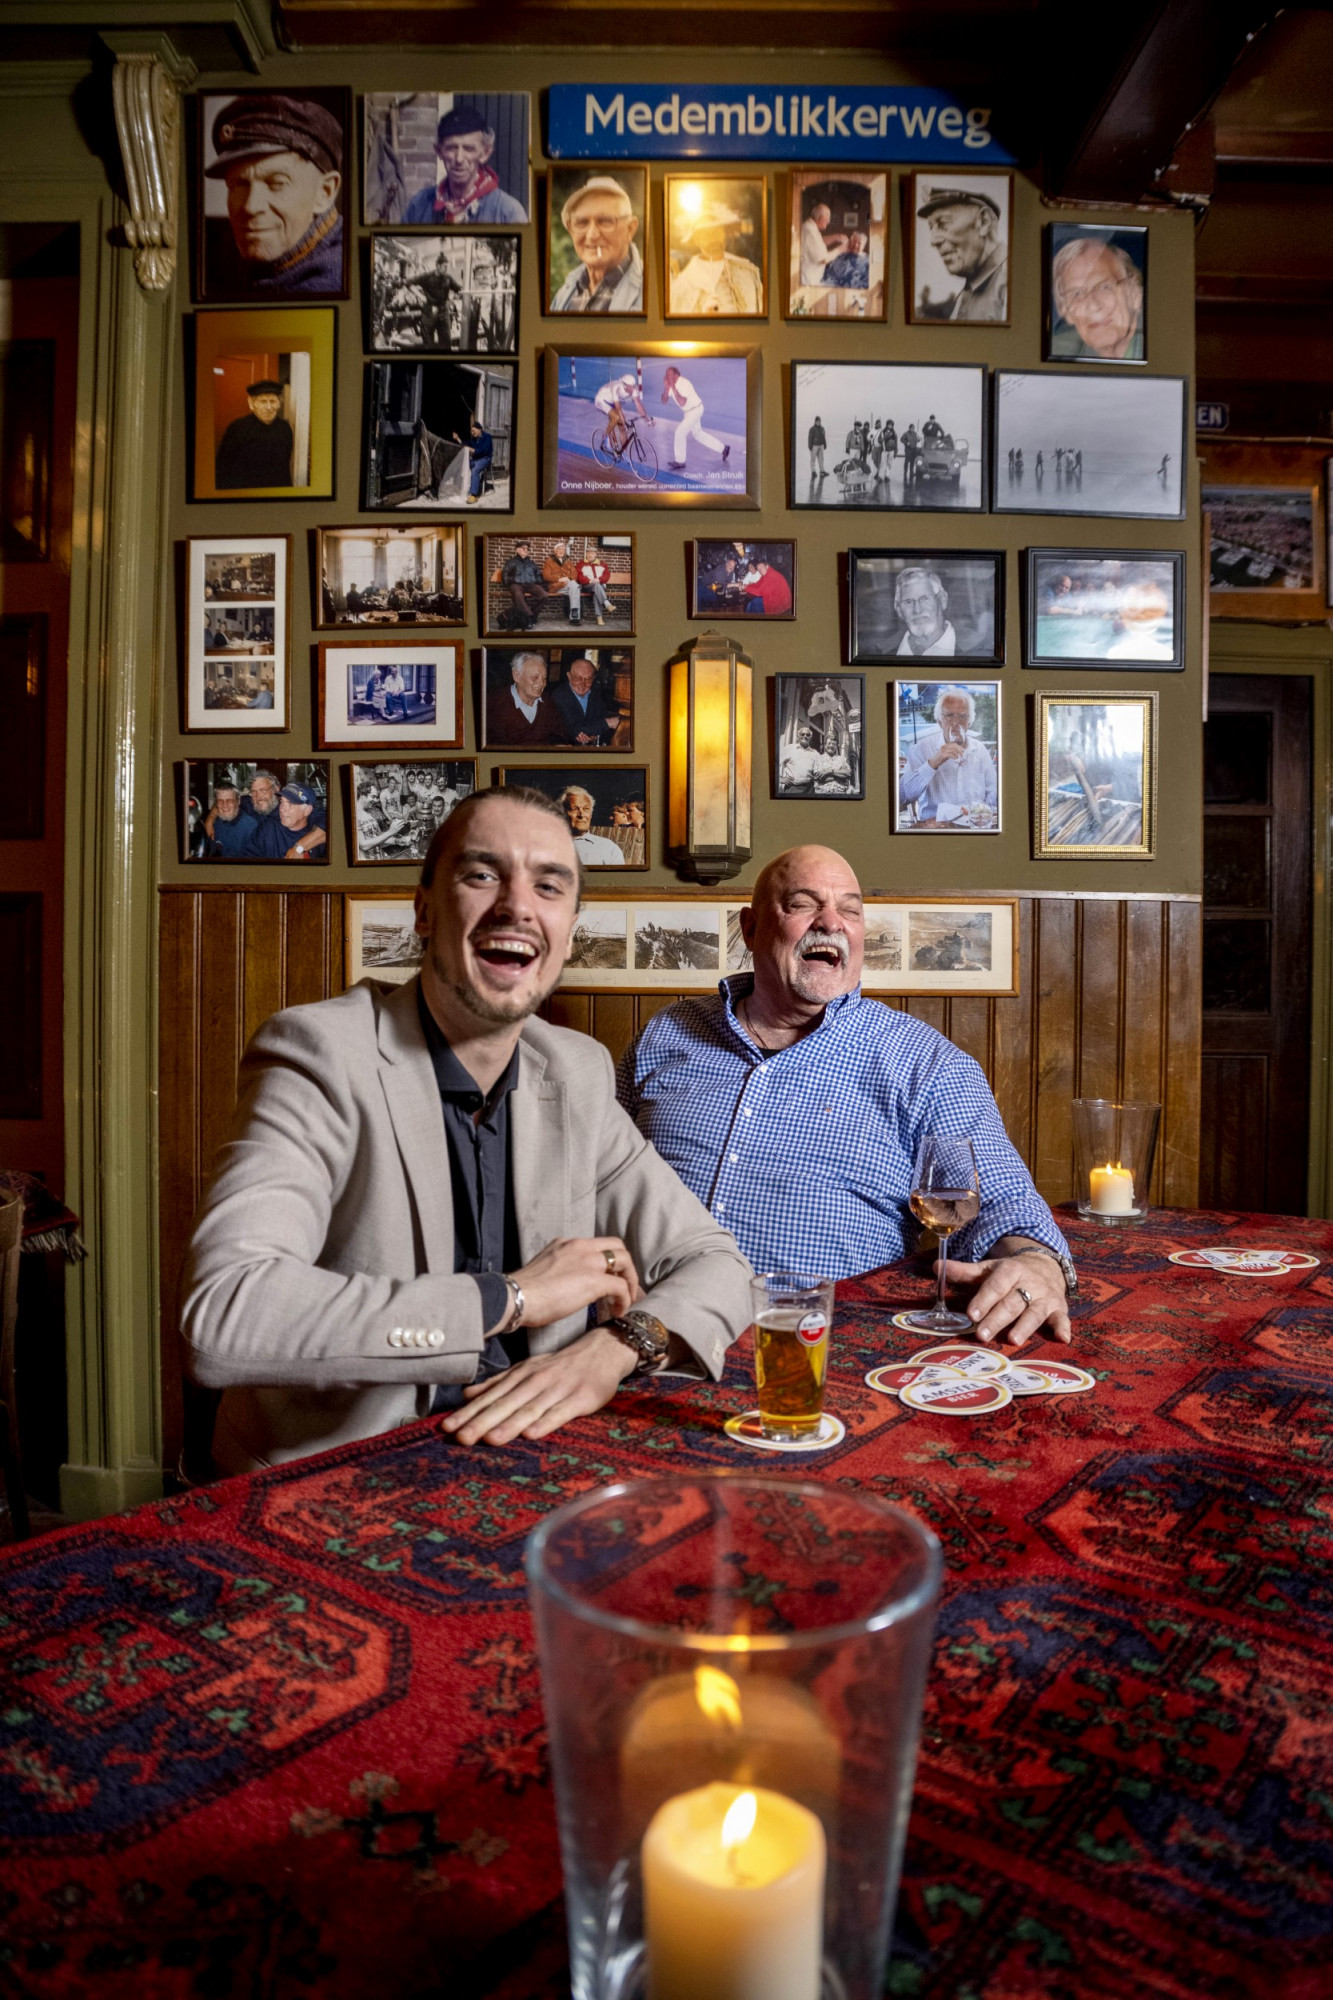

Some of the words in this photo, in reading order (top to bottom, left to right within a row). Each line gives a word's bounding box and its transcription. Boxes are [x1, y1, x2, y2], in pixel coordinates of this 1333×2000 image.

[584, 93, 992, 148] Medemblikkerweg
[706, 471, 720, 479] Jan
[722, 471, 745, 480] Struik
[560, 480, 583, 490] Onne
[584, 480, 614, 491] Nijboer,
[953, 1353, 986, 1370] AMST
[921, 1382, 985, 1401] AMSTEL
[946, 1391, 980, 1403] BIER
